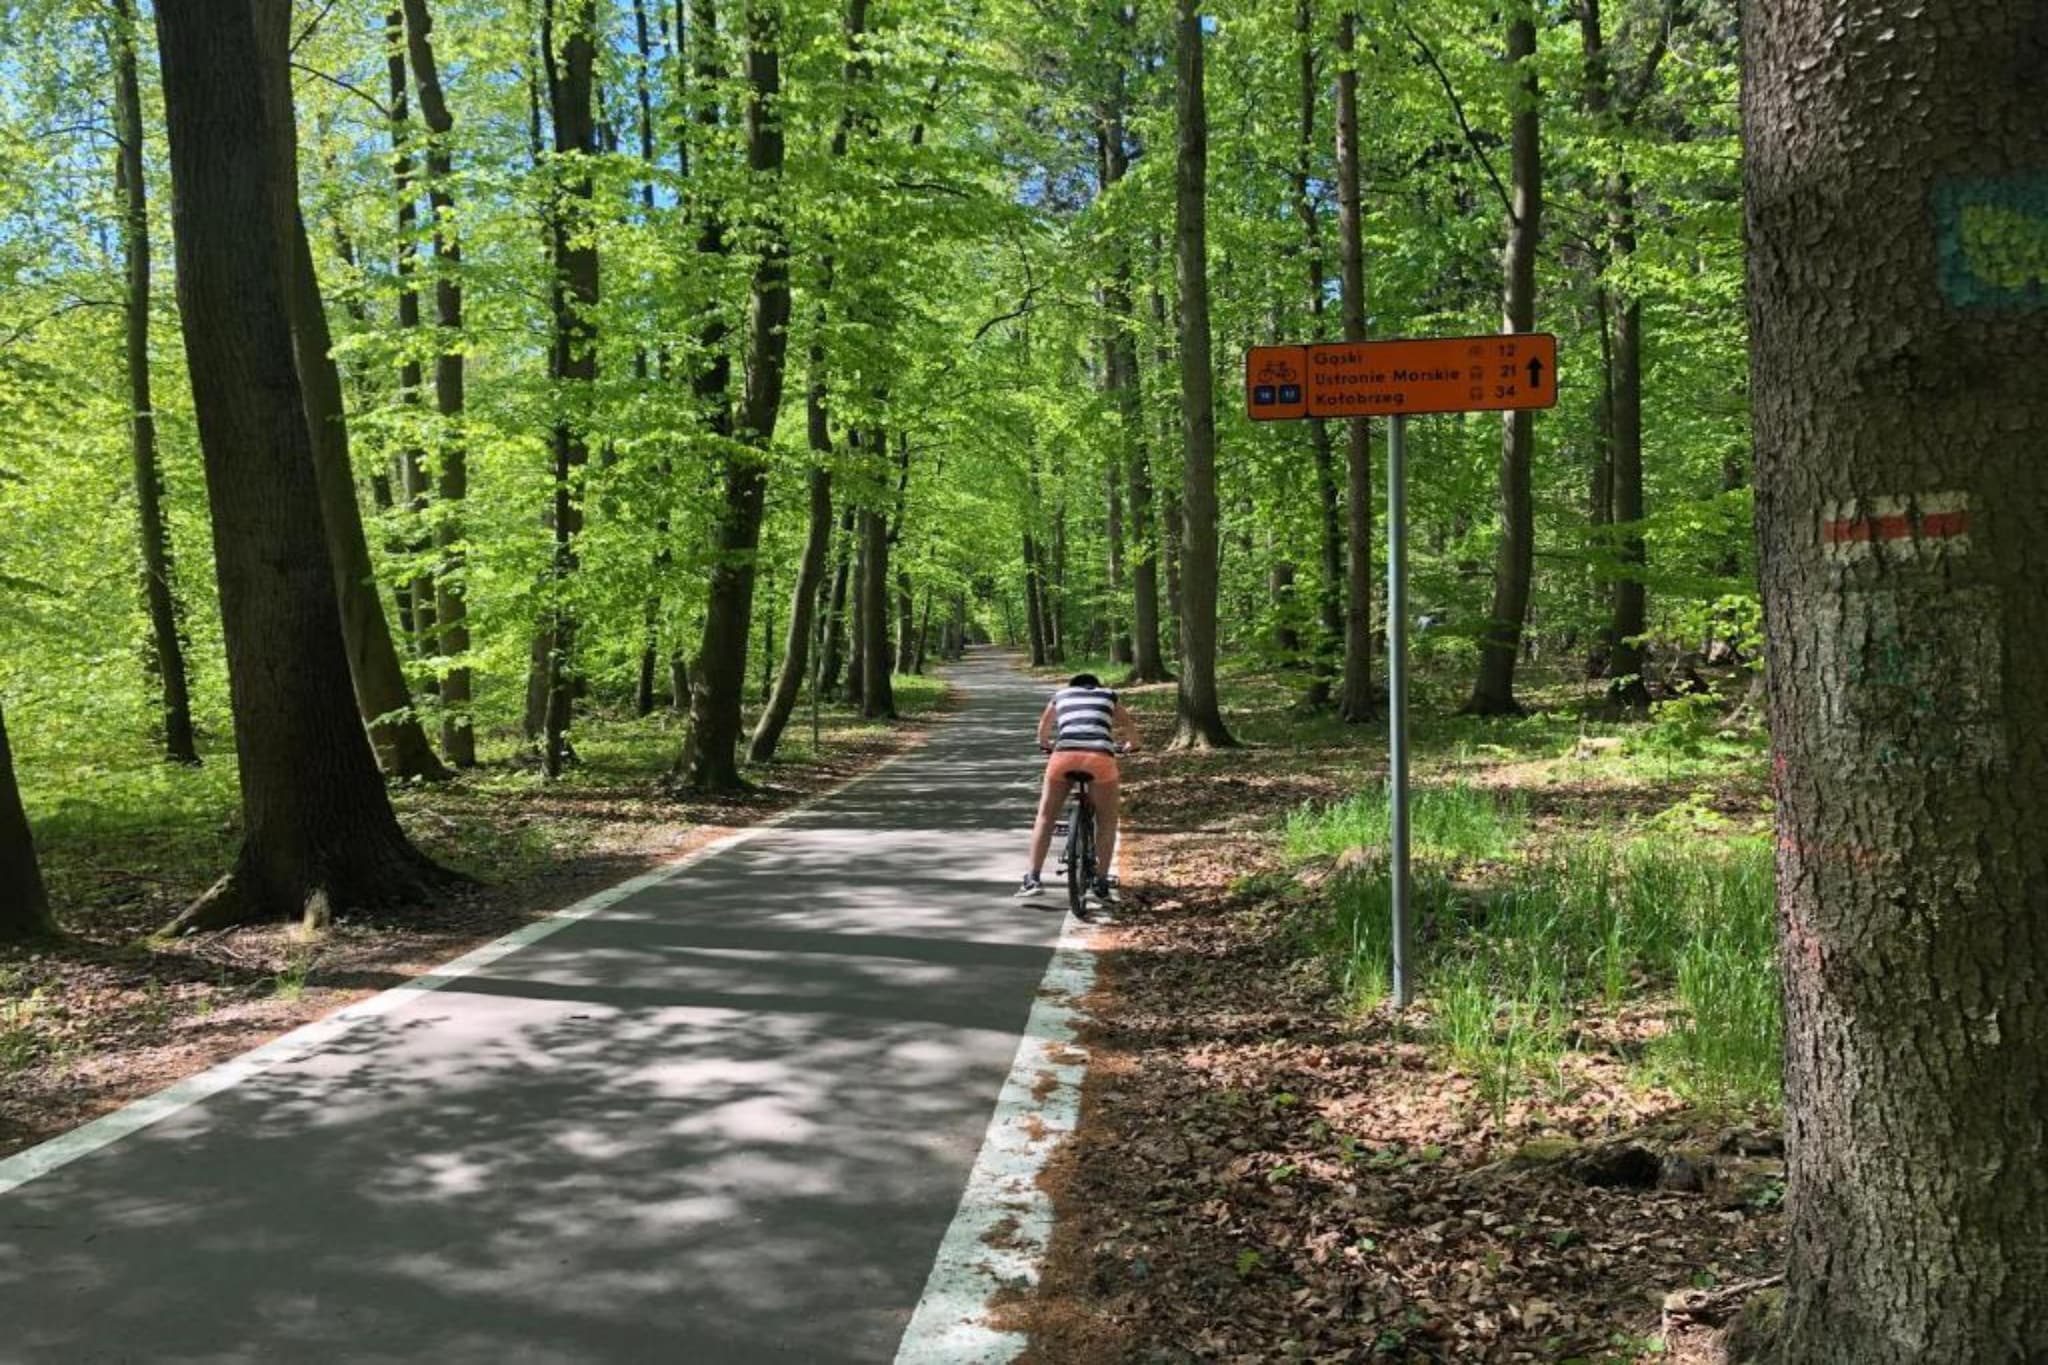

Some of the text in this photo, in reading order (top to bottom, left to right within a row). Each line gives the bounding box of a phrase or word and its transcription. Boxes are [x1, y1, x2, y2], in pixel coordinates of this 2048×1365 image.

[1498, 343, 1516, 357] 12
[1315, 364, 1517, 385] Ustronie Morskie 21
[1495, 384, 1516, 398] 34
